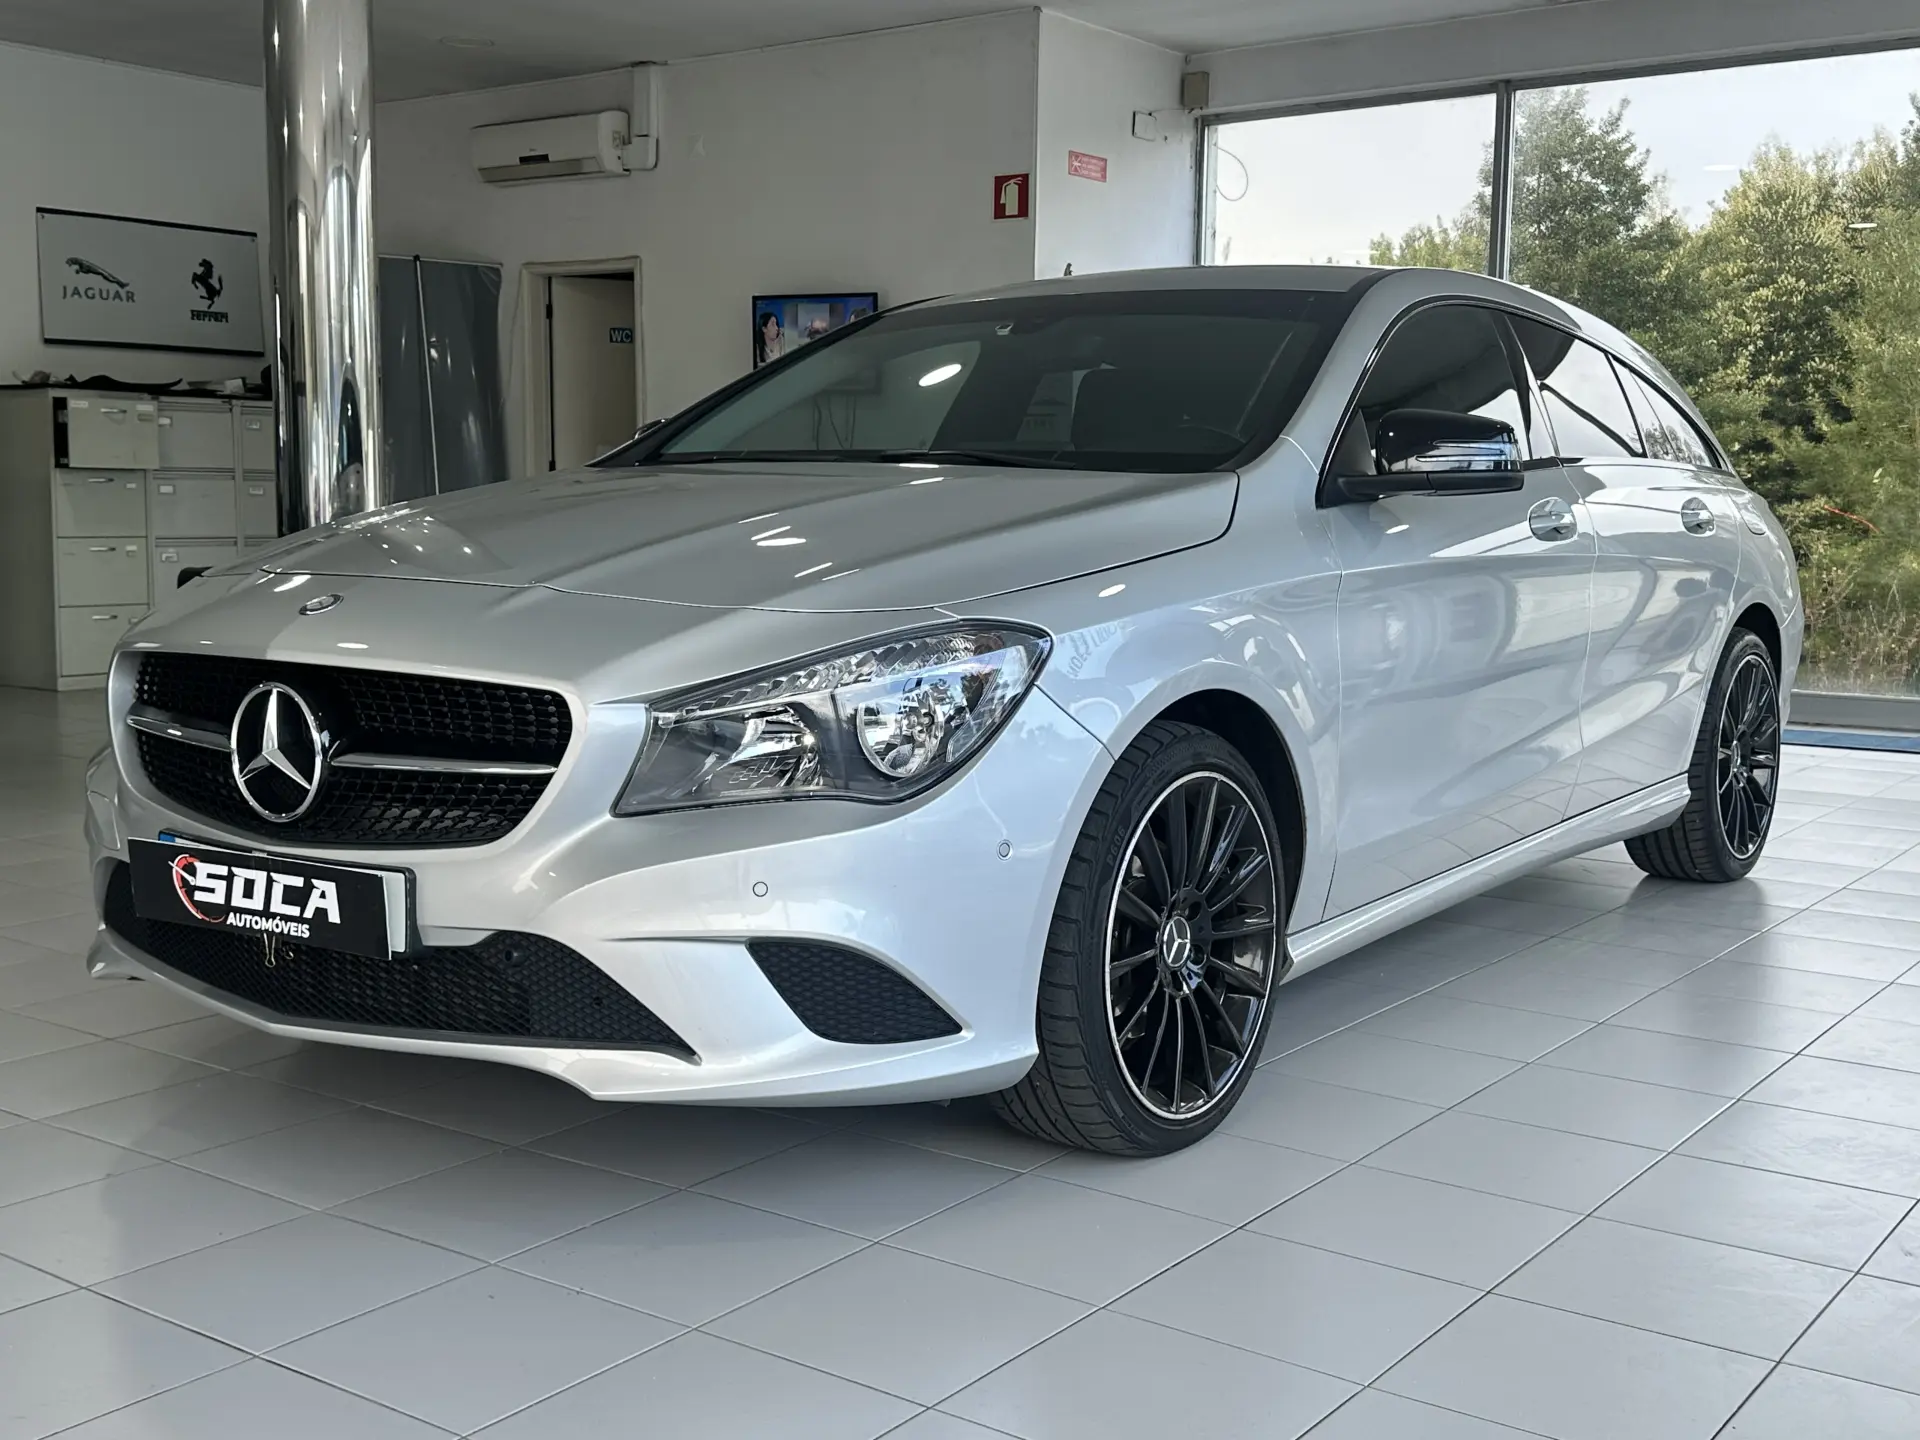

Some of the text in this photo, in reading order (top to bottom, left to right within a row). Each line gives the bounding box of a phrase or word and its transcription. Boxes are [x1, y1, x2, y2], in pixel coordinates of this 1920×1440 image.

[62, 285, 136, 303] JAGUAR
[611, 329, 631, 343] WC
[1106, 824, 1126, 869] P606
[193, 861, 341, 924] SOCA
[226, 912, 310, 939] AUTOMÓVEIS
